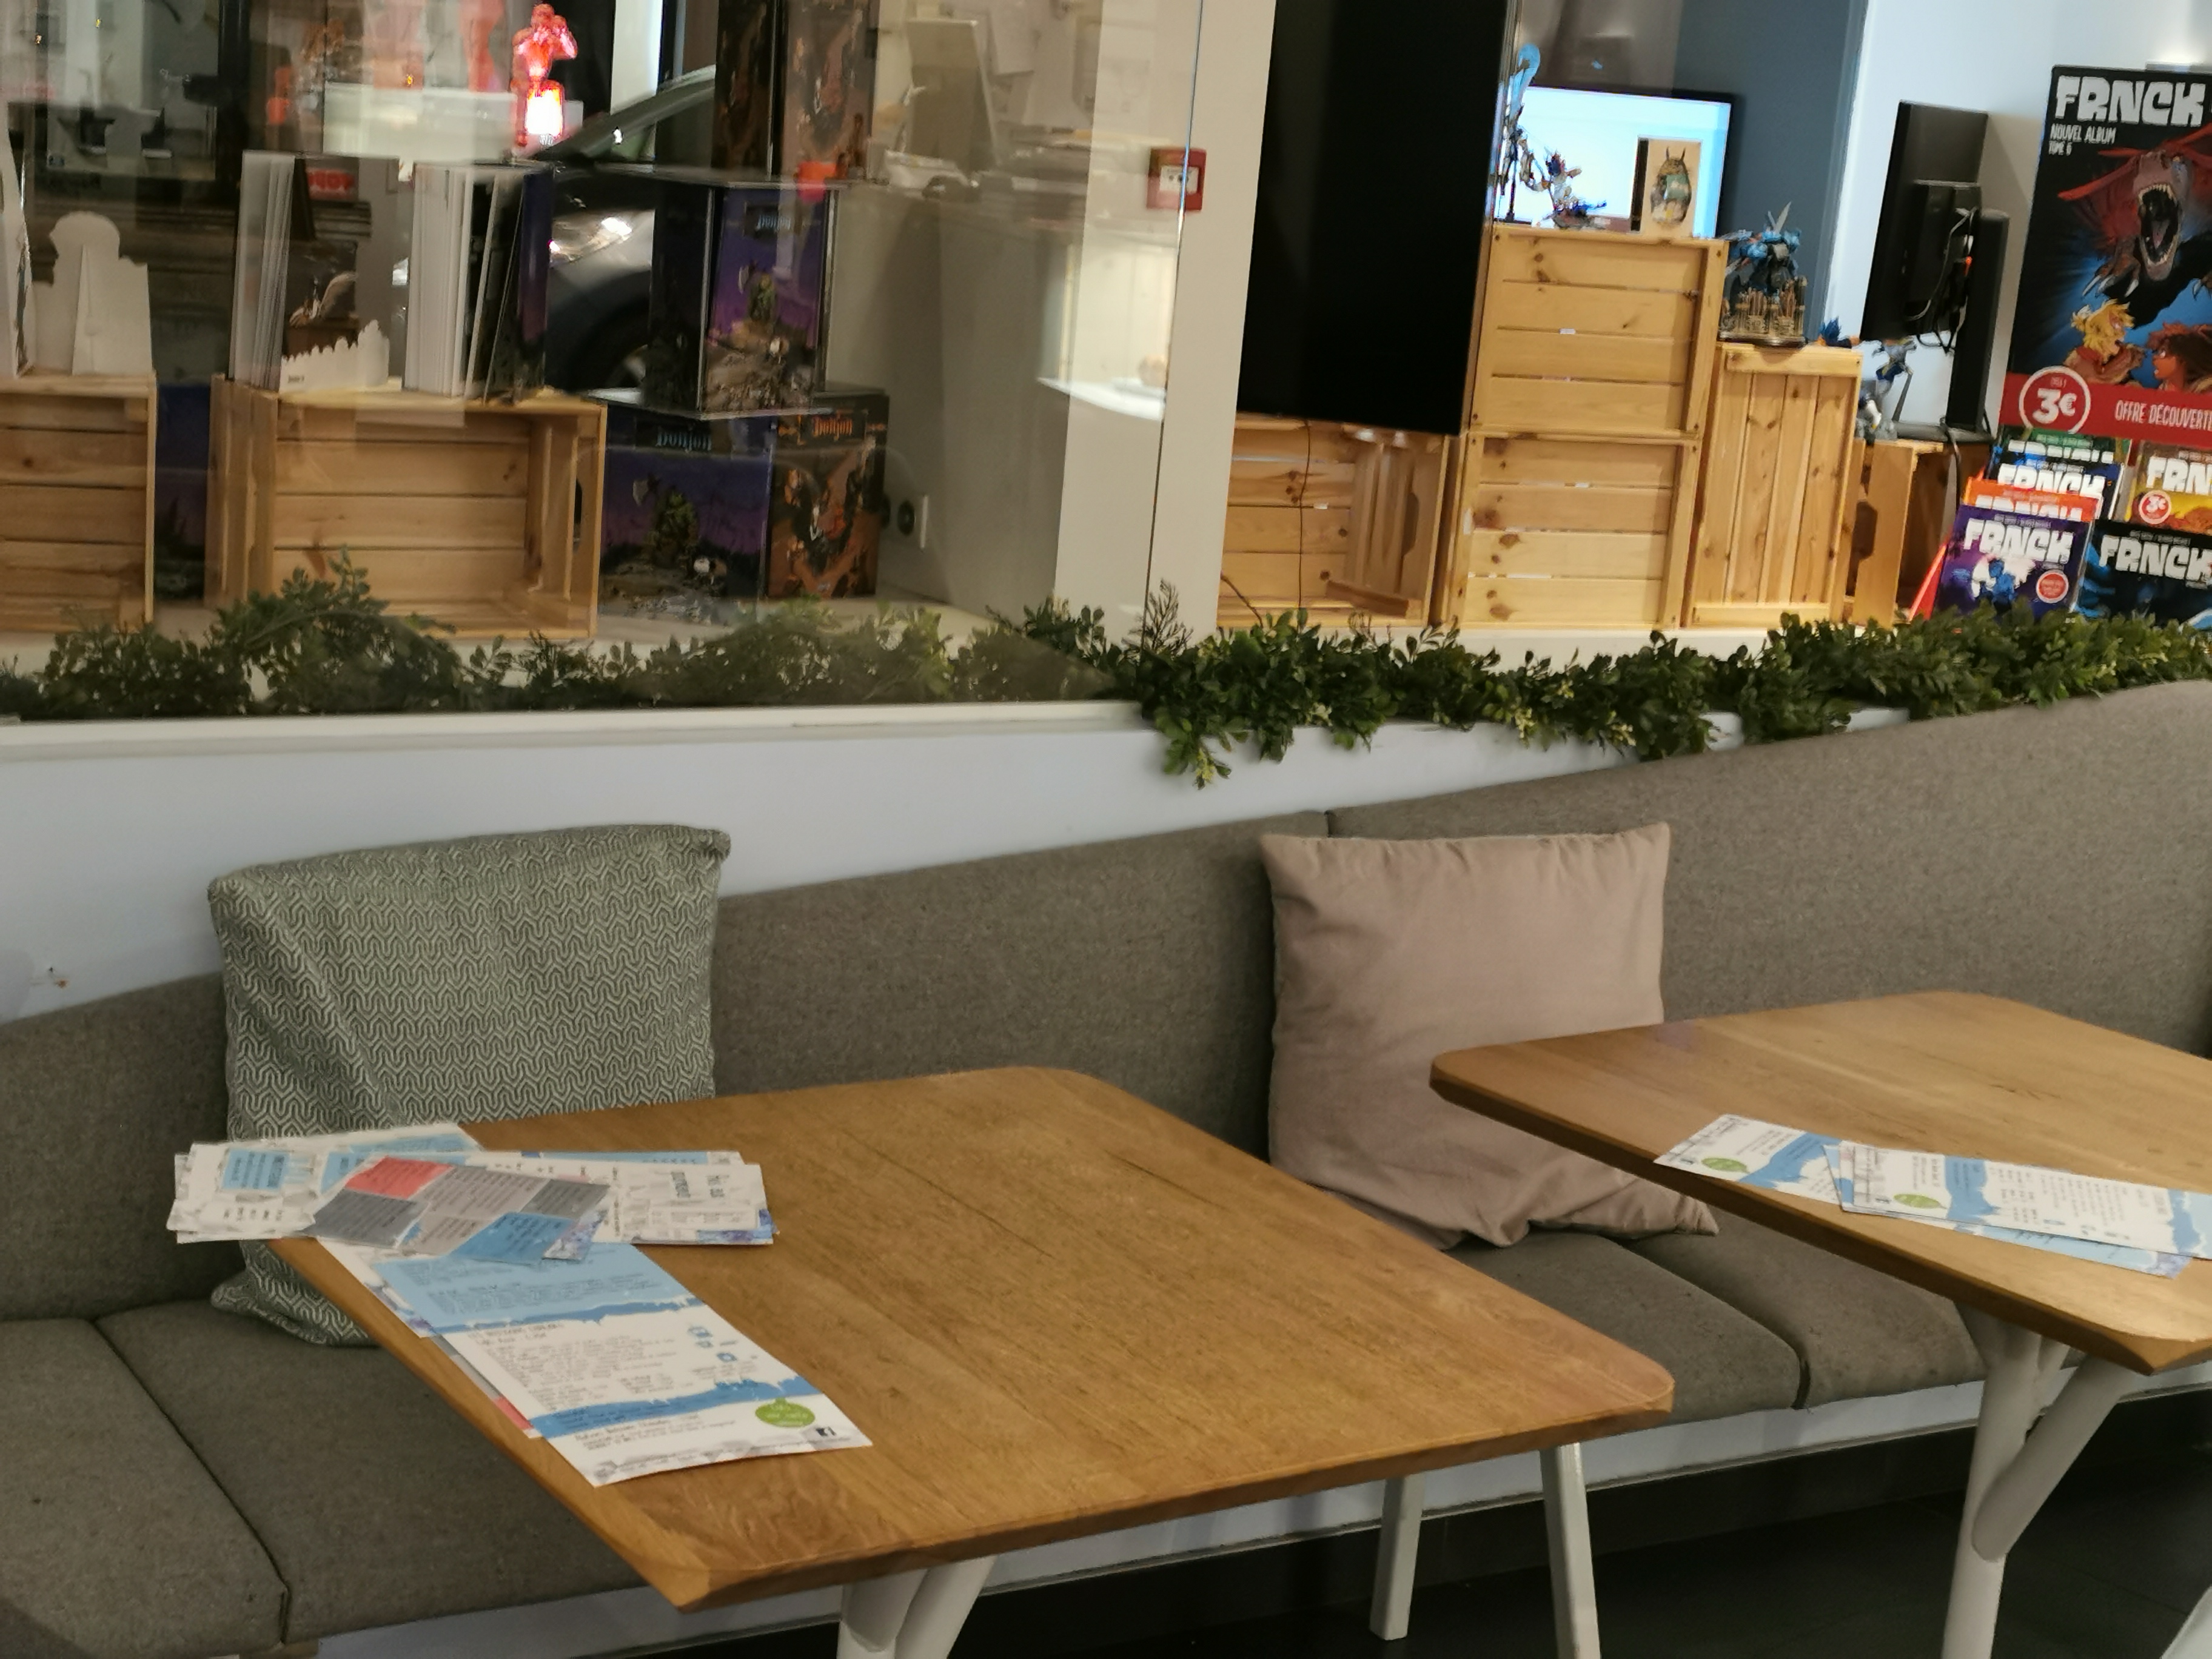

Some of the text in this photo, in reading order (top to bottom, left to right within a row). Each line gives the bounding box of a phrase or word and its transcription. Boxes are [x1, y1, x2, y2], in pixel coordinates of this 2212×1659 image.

[2054, 75, 2206, 127] FRNCK
[2048, 140, 2065, 155] TOME
[2050, 123, 2117, 144] NOUVEL ALBUM
[2032, 388, 2077, 424] 3€
[2115, 400, 2147, 423] OFFRE
[1963, 517, 2074, 564] FRNCK
[2099, 534, 2212, 583] FRNCK
